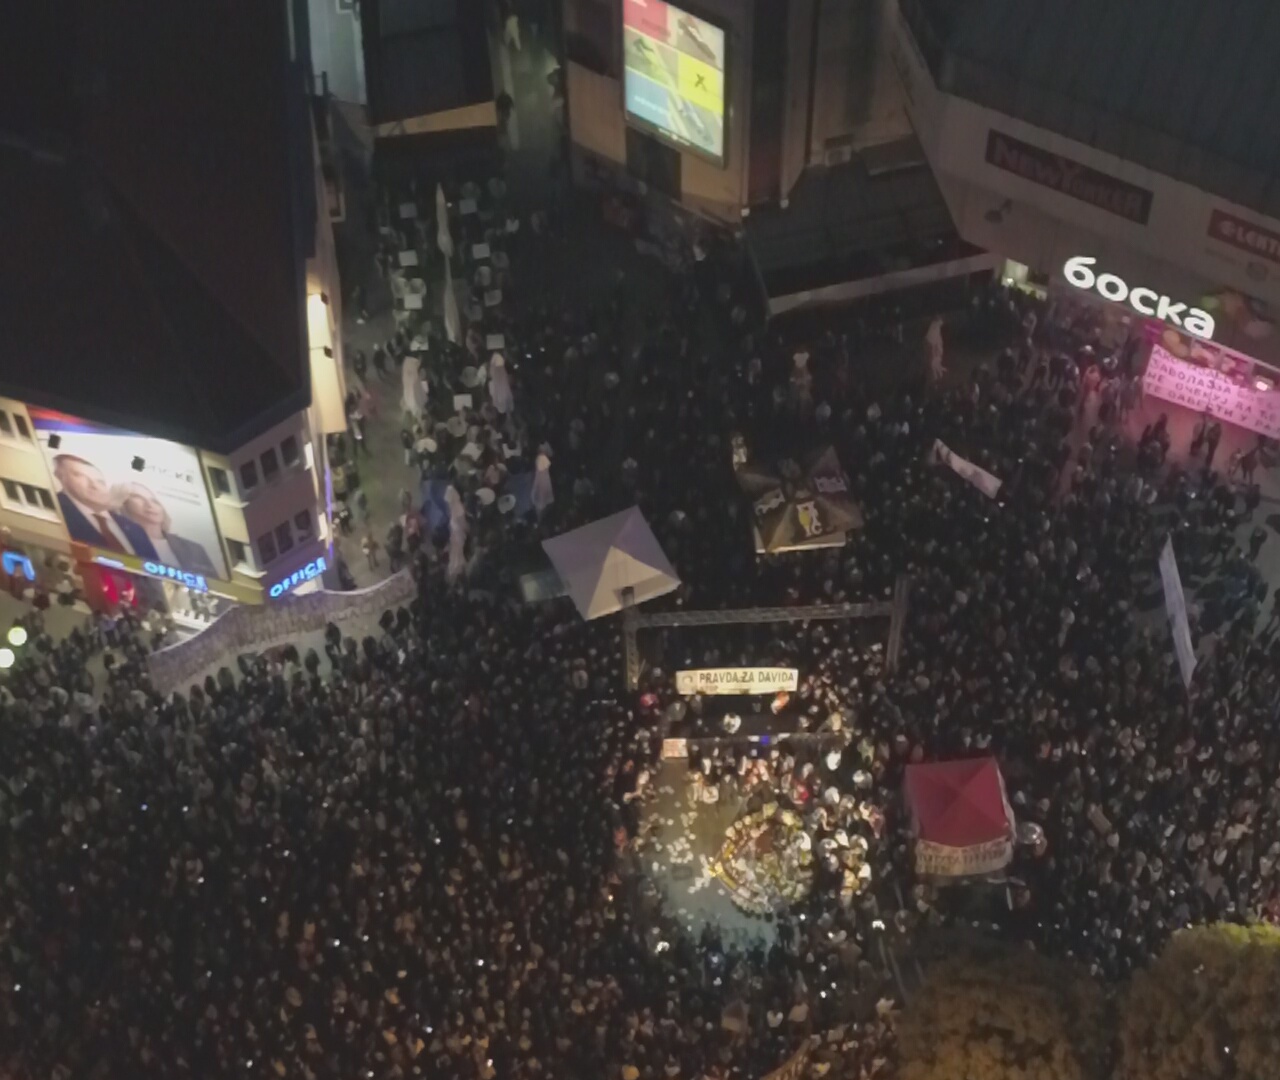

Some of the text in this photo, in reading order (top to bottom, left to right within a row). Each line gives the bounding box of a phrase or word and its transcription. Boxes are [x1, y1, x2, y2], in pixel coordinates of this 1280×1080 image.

[1063, 256, 1215, 340] боска
[143, 561, 205, 587] OFFICE
[270, 557, 326, 597] OFFICE
[699, 671, 738, 684] PRAVDA
[758, 671, 794, 683] DAVIDA
